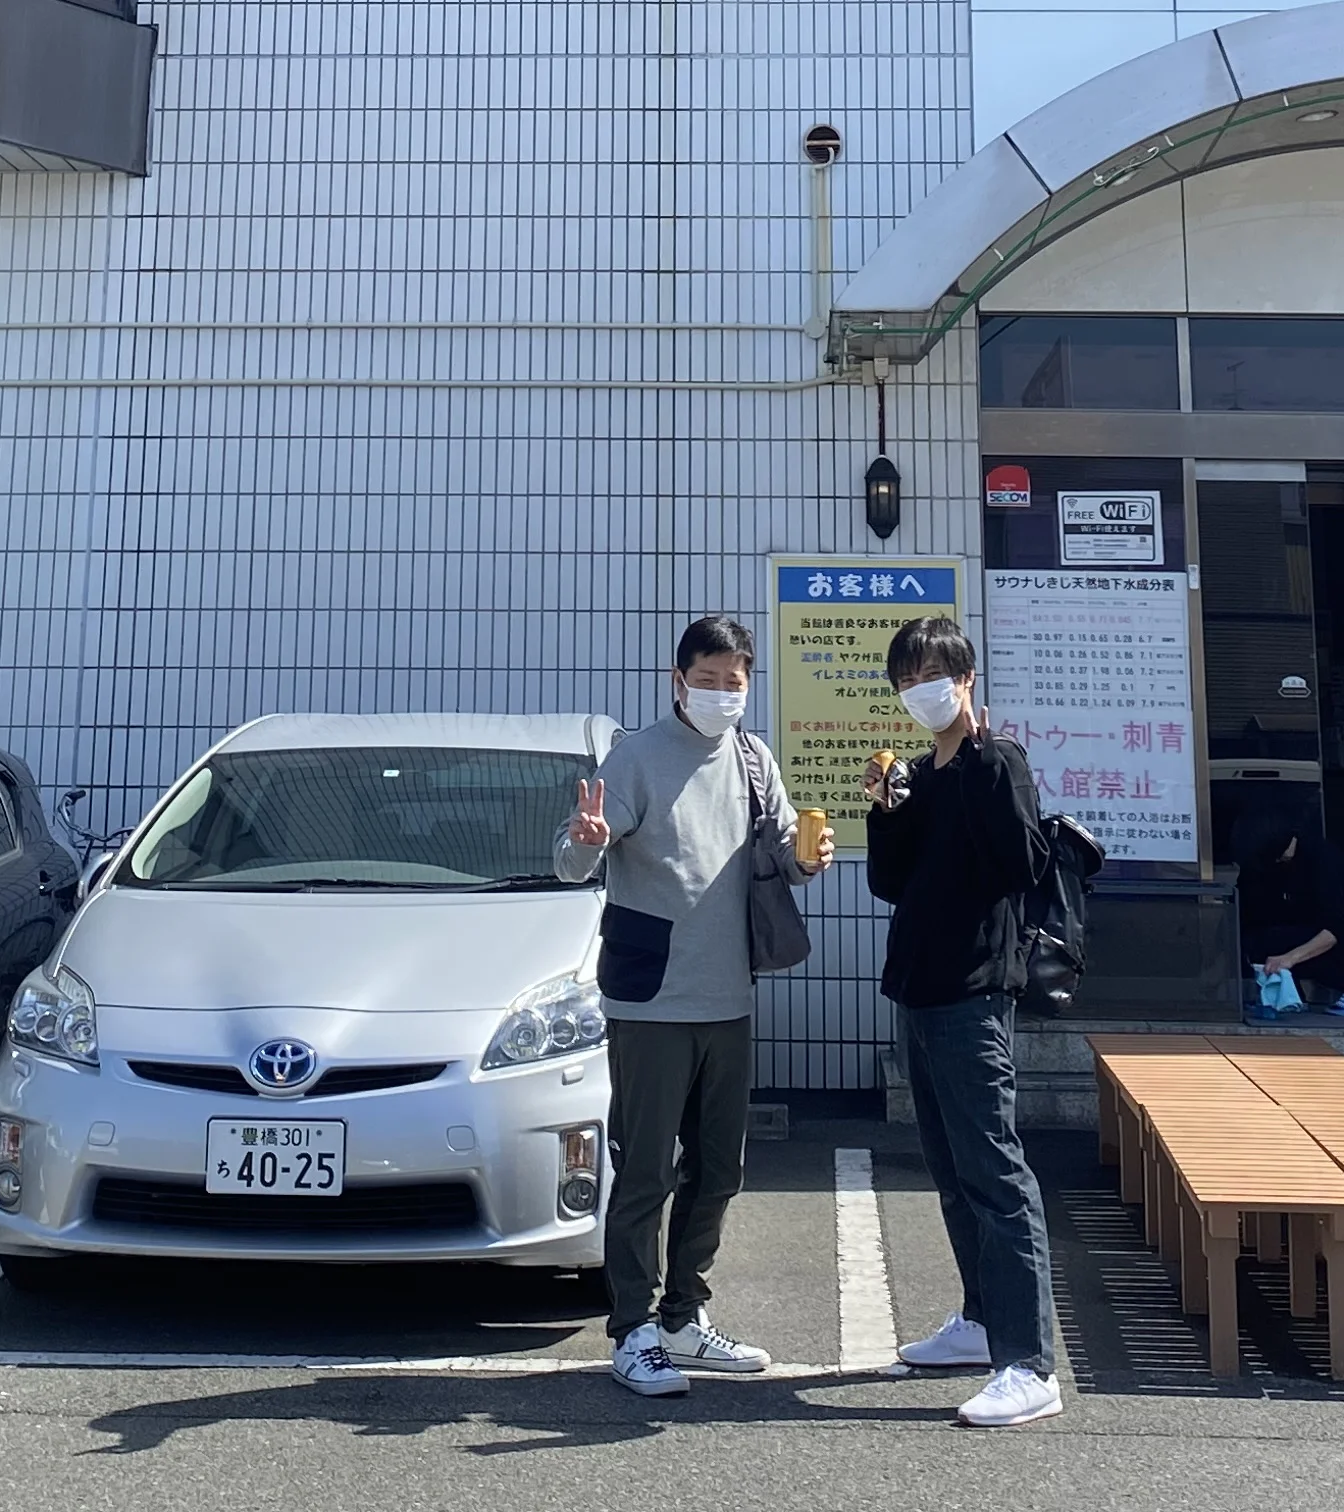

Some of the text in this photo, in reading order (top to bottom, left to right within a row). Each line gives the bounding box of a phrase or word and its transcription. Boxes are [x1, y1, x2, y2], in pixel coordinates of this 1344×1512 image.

[1067, 503, 1148, 520] FREE WiFi
[807, 573, 925, 597] お客様へ
[994, 577, 1175, 592] サウナしきじ天然地下水成分表
[1032, 767, 1162, 800] 入館禁止
[241, 1127, 310, 1147] 豊橋301
[217, 1151, 336, 1189] ち 40-25
